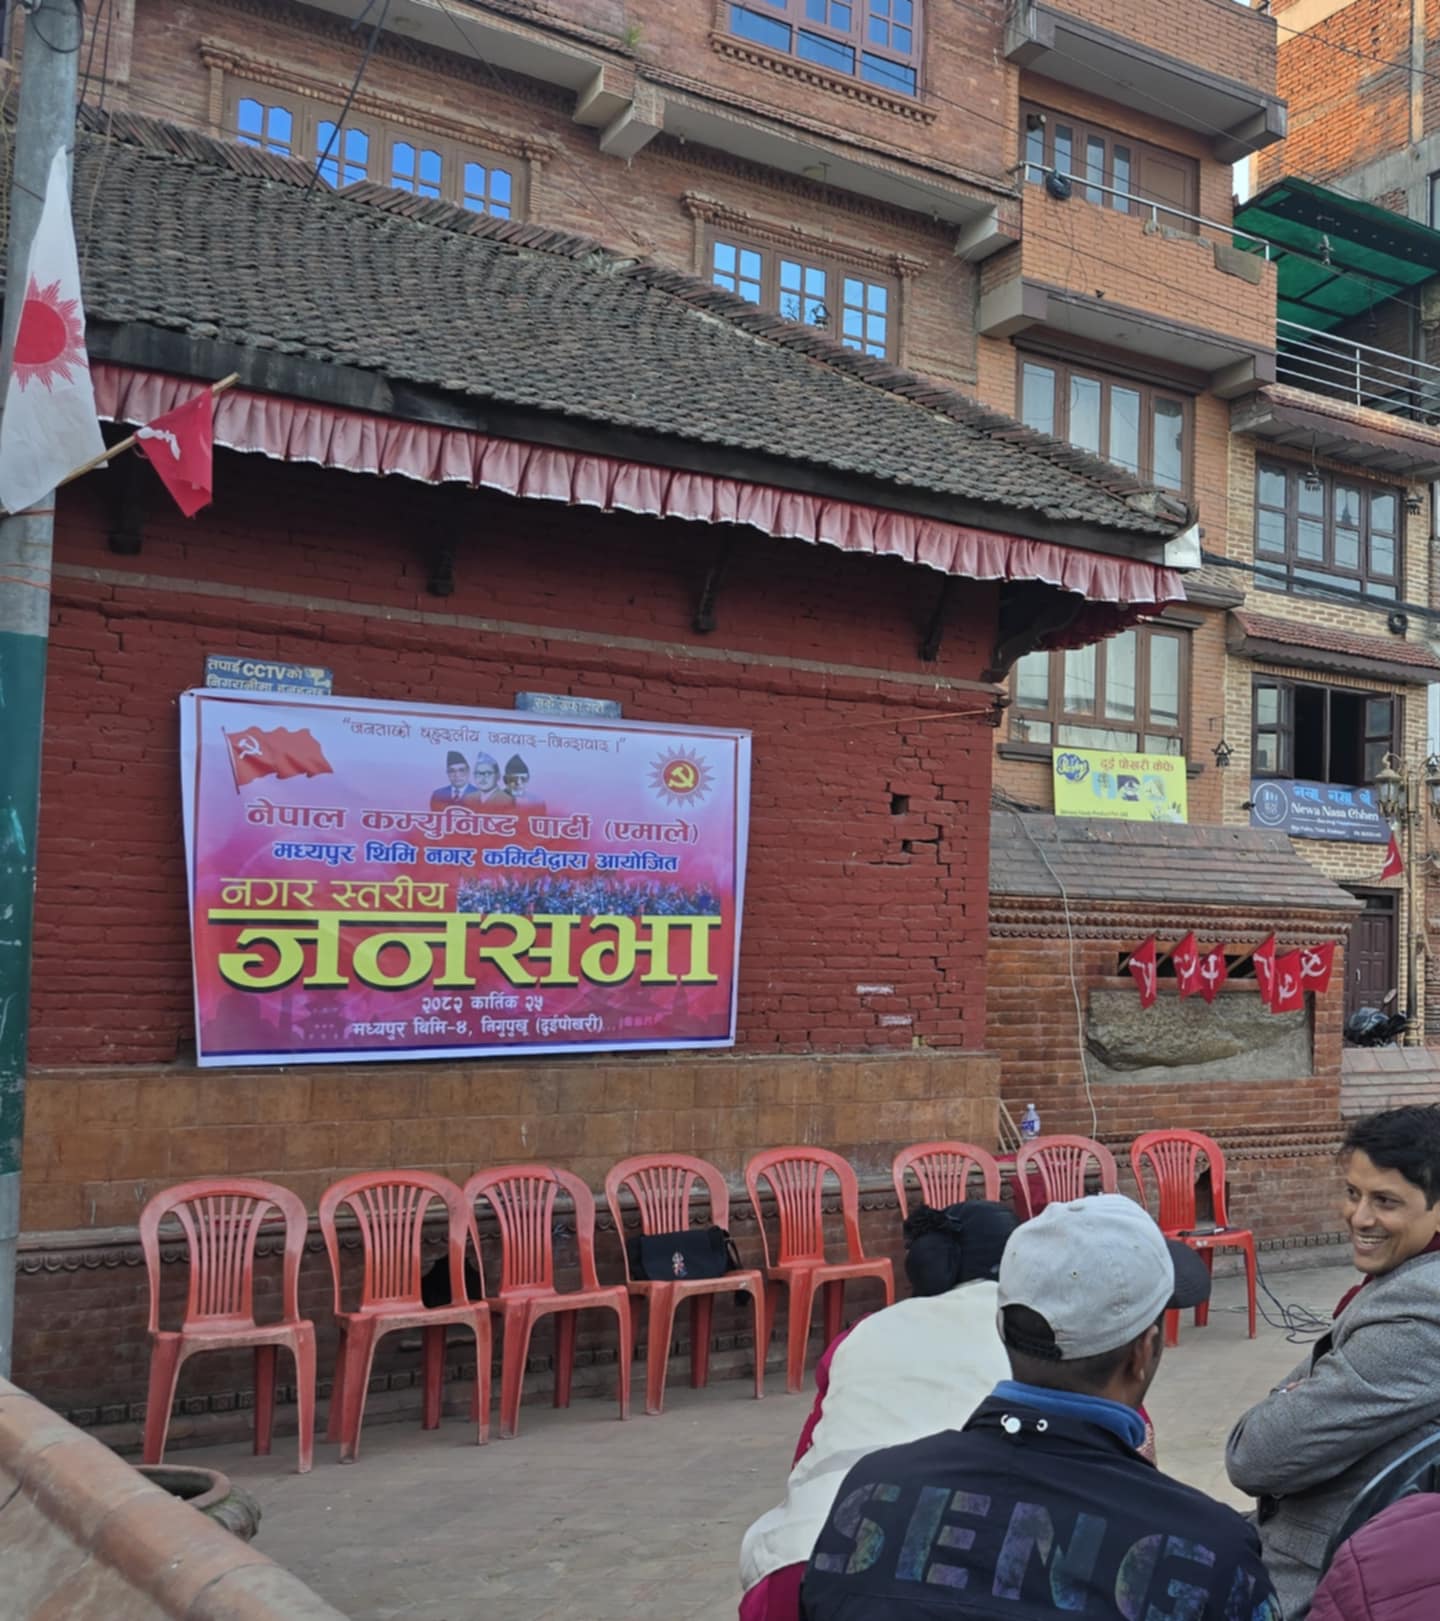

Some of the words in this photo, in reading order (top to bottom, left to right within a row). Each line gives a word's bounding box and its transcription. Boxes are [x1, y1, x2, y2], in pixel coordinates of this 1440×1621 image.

[246, 801, 345, 829] नेपाल
[361, 805, 518, 840] कम्युनिष्ट
[528, 811, 592, 841] पार्टी
[605, 816, 700, 844] (एमाले)
[273, 840, 356, 864] मध्यपुर
[365, 840, 416, 864] थिमि
[425, 846, 476, 867] नगर
[483, 845, 588, 872] कमिटीद्वारा
[596, 850, 679, 873] आयोजित
[221, 877, 318, 909] नगर
[330, 873, 450, 910] स्तरीय
[207, 908, 723, 992] जनसभा
[421, 995, 463, 1014] २०८२
[470, 994, 519, 1010] कार्तिक
[352, 1020, 407, 1041] मध्यपुर
